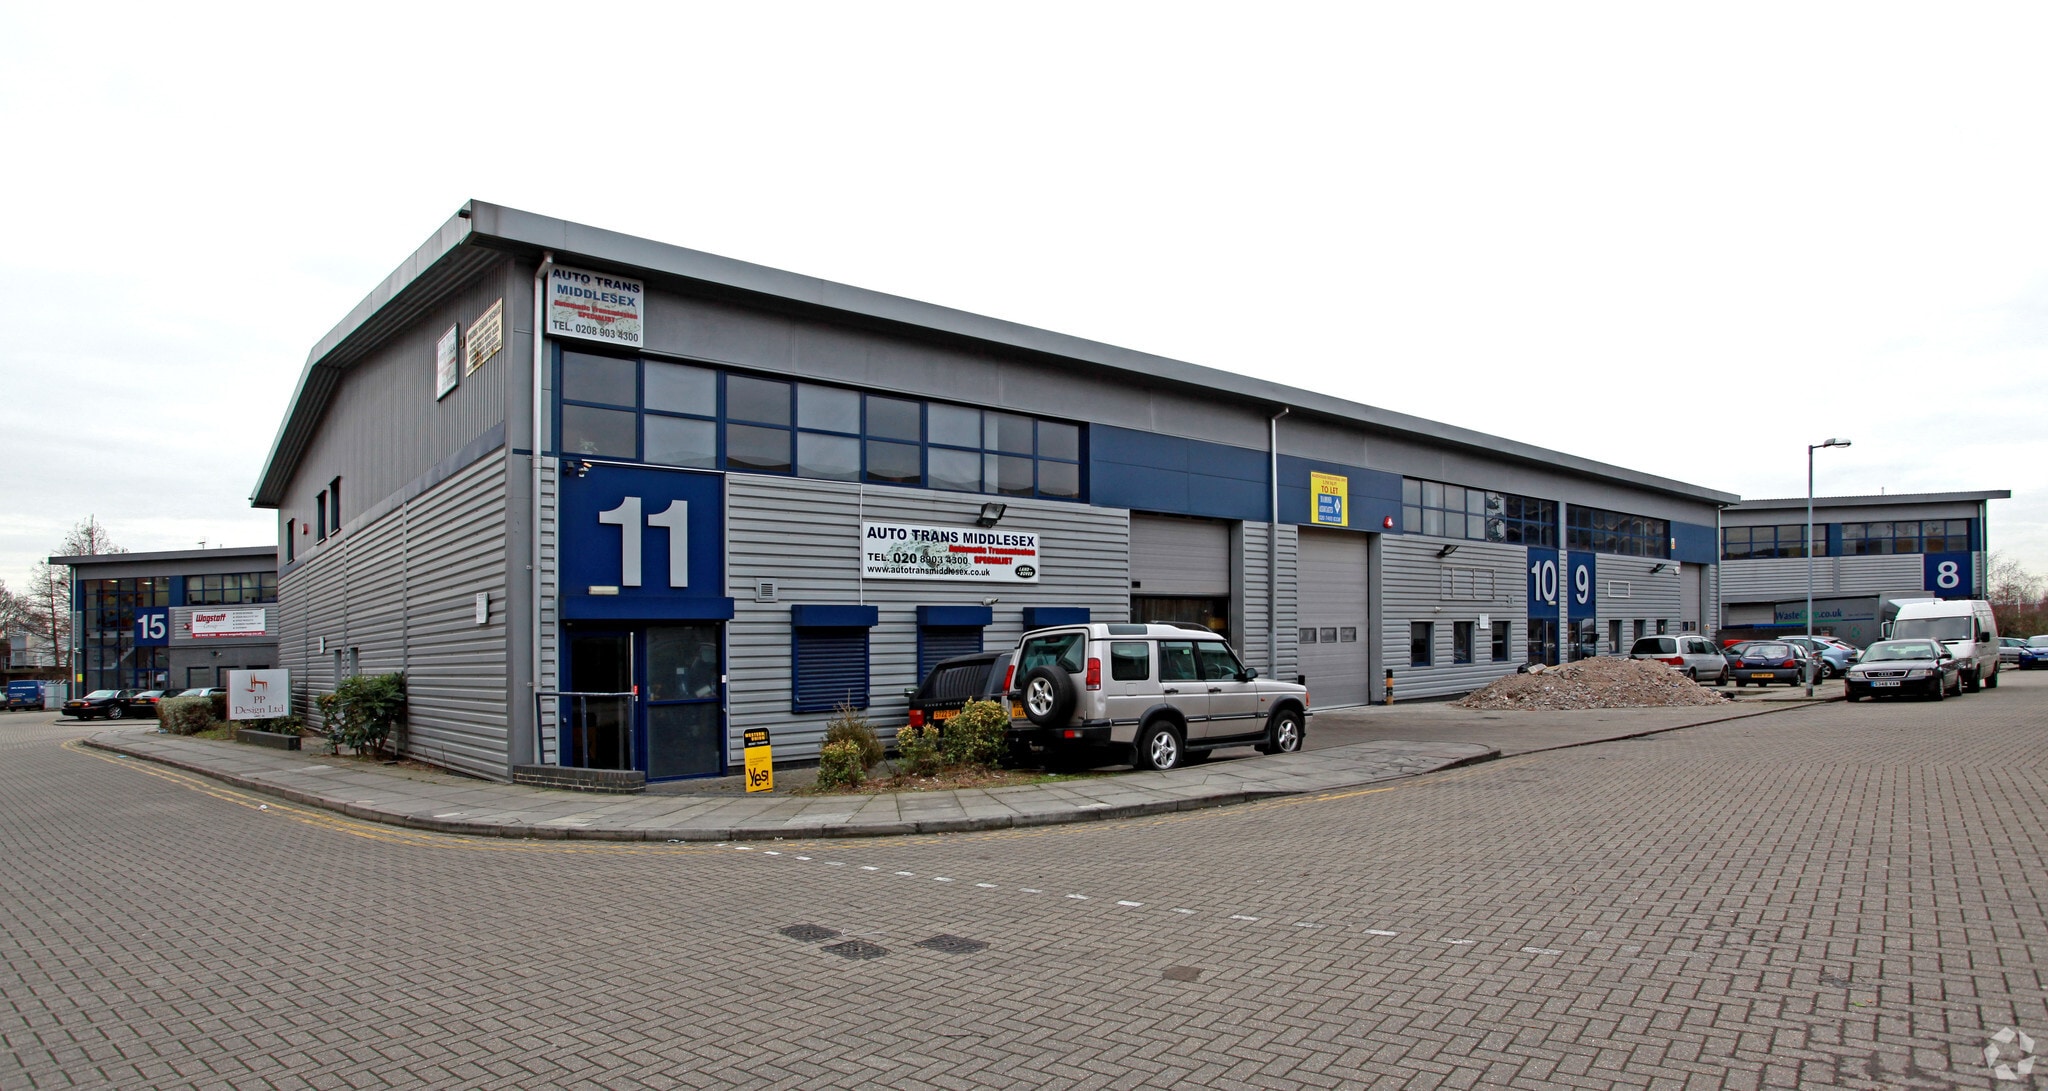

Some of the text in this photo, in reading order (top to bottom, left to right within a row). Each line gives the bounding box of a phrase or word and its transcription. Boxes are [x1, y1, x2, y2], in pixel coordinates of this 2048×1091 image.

[552, 268, 641, 293] AUTO TRANS
[557, 284, 635, 307] MIDDLESEX
[552, 320, 639, 342] TEL. 0208 903 4300
[1321, 485, 1339, 495] TO LET
[598, 496, 689, 588] 11
[867, 526, 1035, 547] AUTO TRANS MIDDLESEX
[867, 552, 968, 565] TEL. 020 8903 4300
[974, 555, 1013, 565] SPECIALIST
[867, 565, 991, 577] www.autotransmiddlesex.co.uk
[1531, 560, 1557, 602] 10
[1937, 561, 1960, 589] 8
[1575, 564, 1589, 605] 9
[137, 614, 166, 639] 15
[196, 613, 227, 623] Wagstaff
[235, 704, 284, 714] Design Ltd
[254, 695, 266, 704] PP
